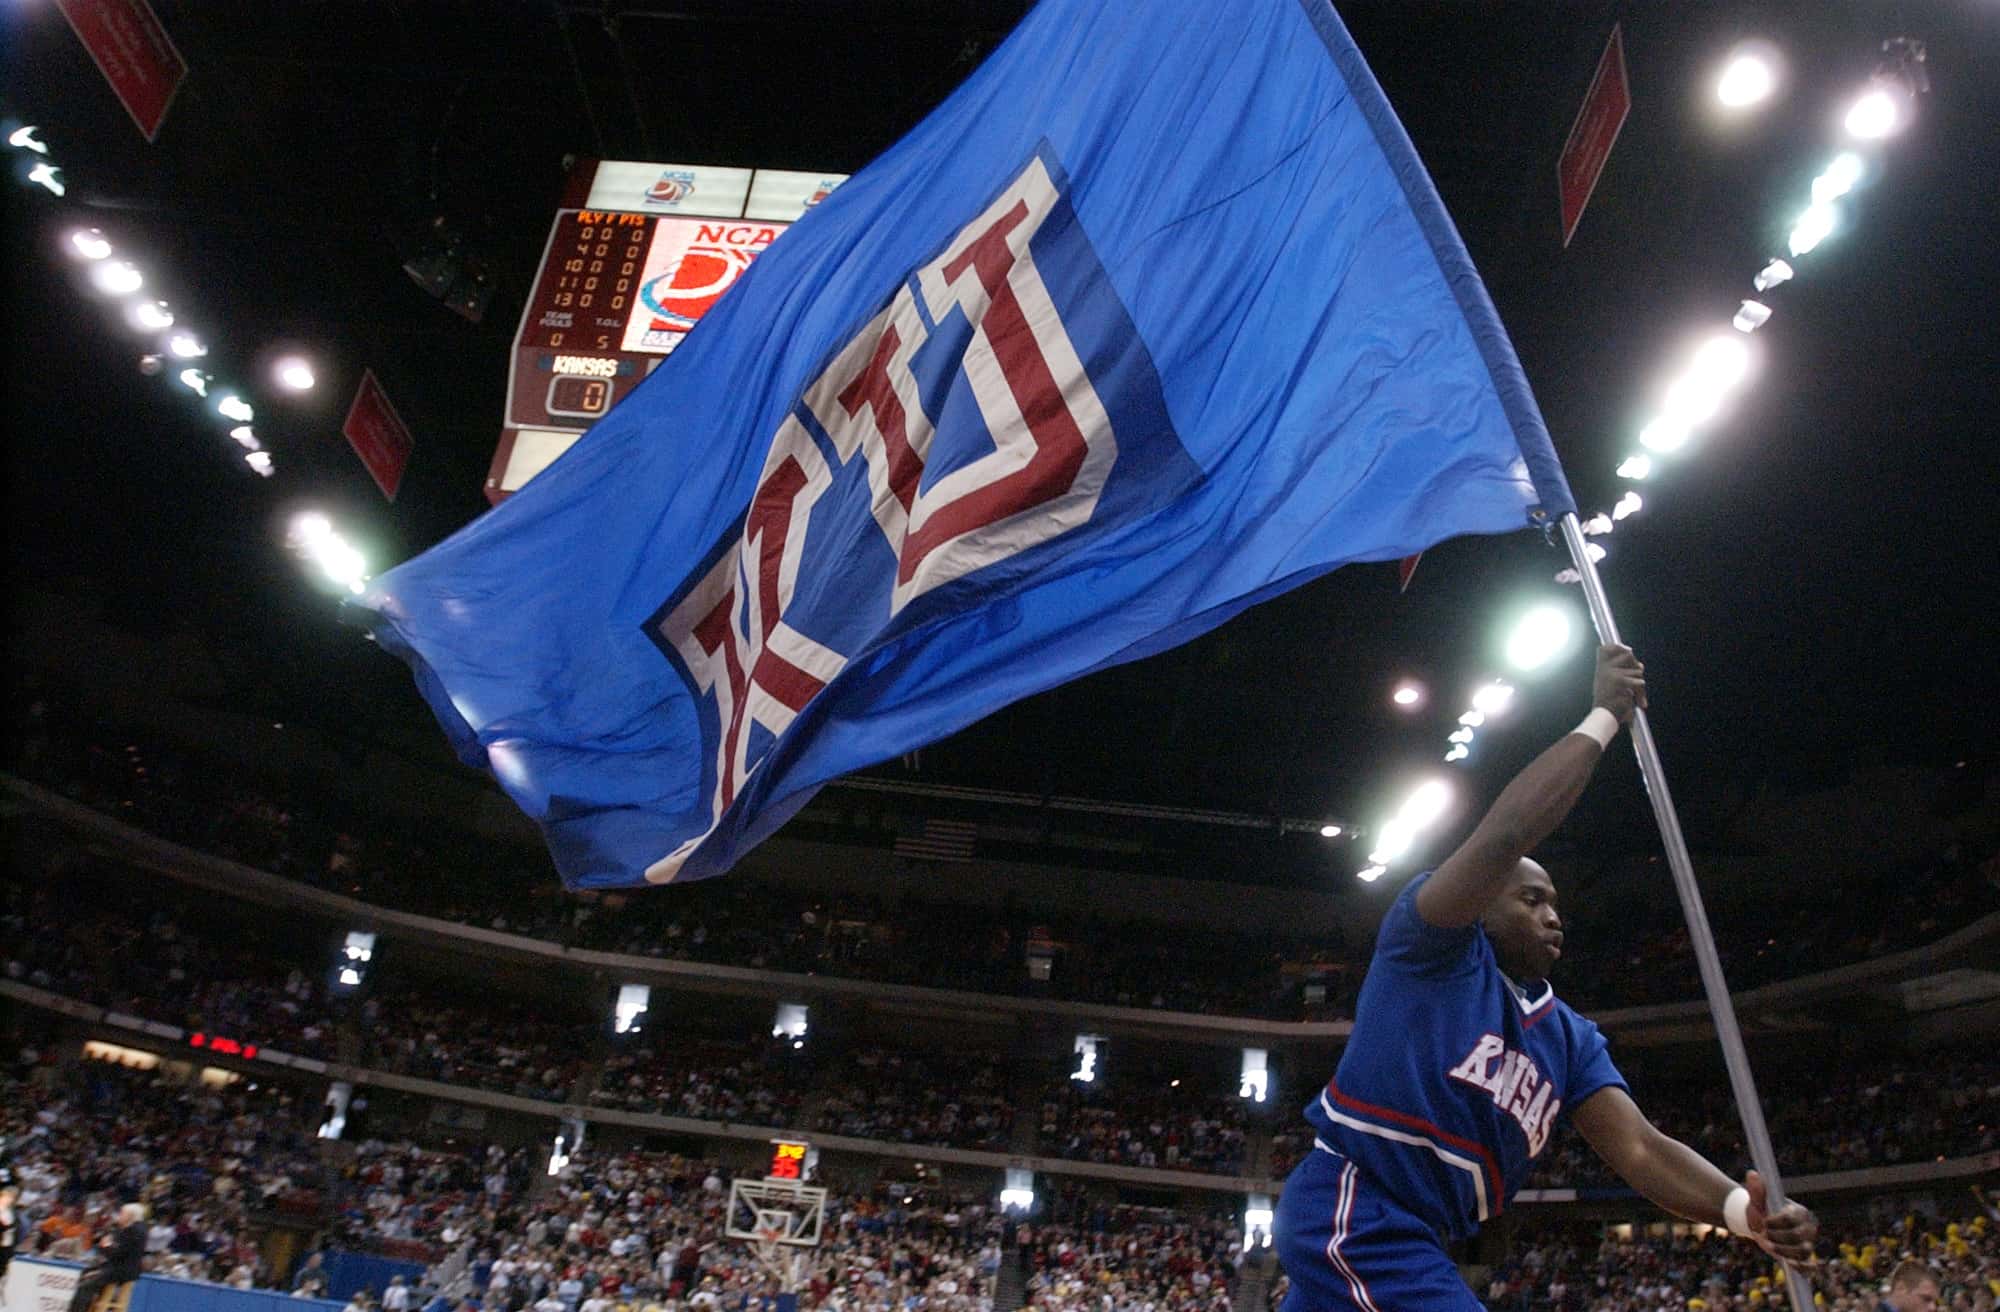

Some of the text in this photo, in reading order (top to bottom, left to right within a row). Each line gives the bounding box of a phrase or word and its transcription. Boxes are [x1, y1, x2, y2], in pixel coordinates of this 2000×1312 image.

[619, 213, 645, 226] PTS
[581, 227, 644, 242] 0 0 0
[695, 225, 776, 245] NCA
[595, 244, 608, 257] 0
[626, 246, 639, 259] 0
[565, 260, 634, 275] 10 0 0
[585, 277, 598, 290] 0
[616, 279, 628, 292] 0
[579, 294, 592, 307] 0
[611, 295, 624, 309] 0
[550, 333, 563, 347] 0
[552, 355, 619, 377] KANSAS
[582, 383, 605, 411] 0
[1449, 1033, 1561, 1158] KANSAS
